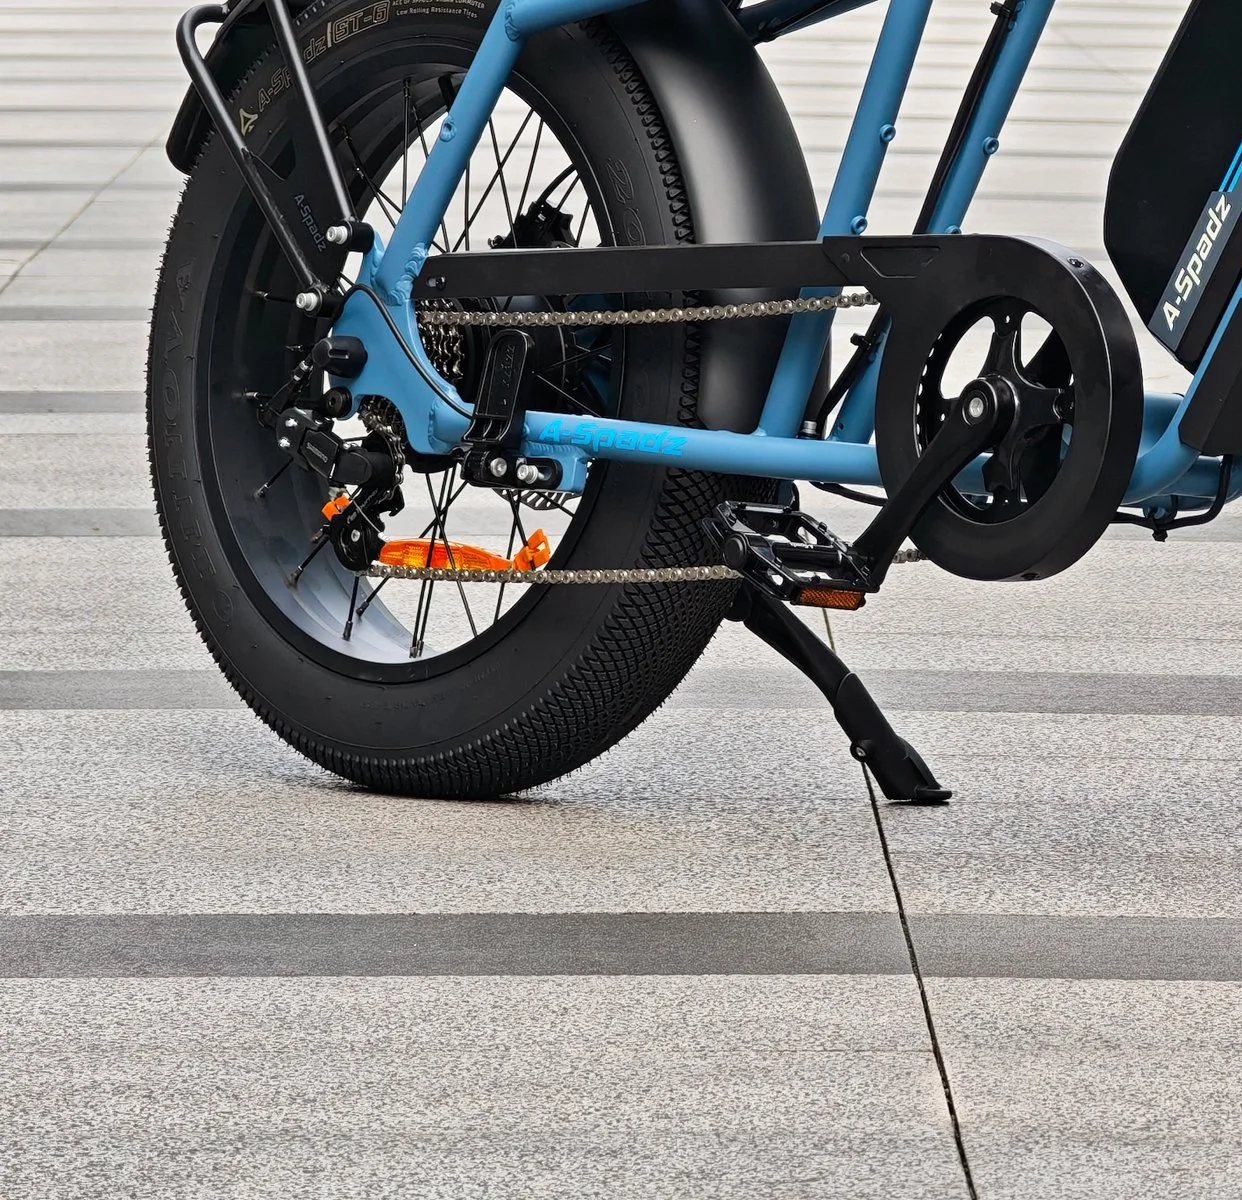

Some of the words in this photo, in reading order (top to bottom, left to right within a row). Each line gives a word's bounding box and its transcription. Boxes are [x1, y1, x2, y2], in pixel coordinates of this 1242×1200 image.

[294, 193, 328, 253] A-Spadz
[1162, 194, 1232, 332] A-Spadz
[537, 419, 689, 456] A-Spadz
